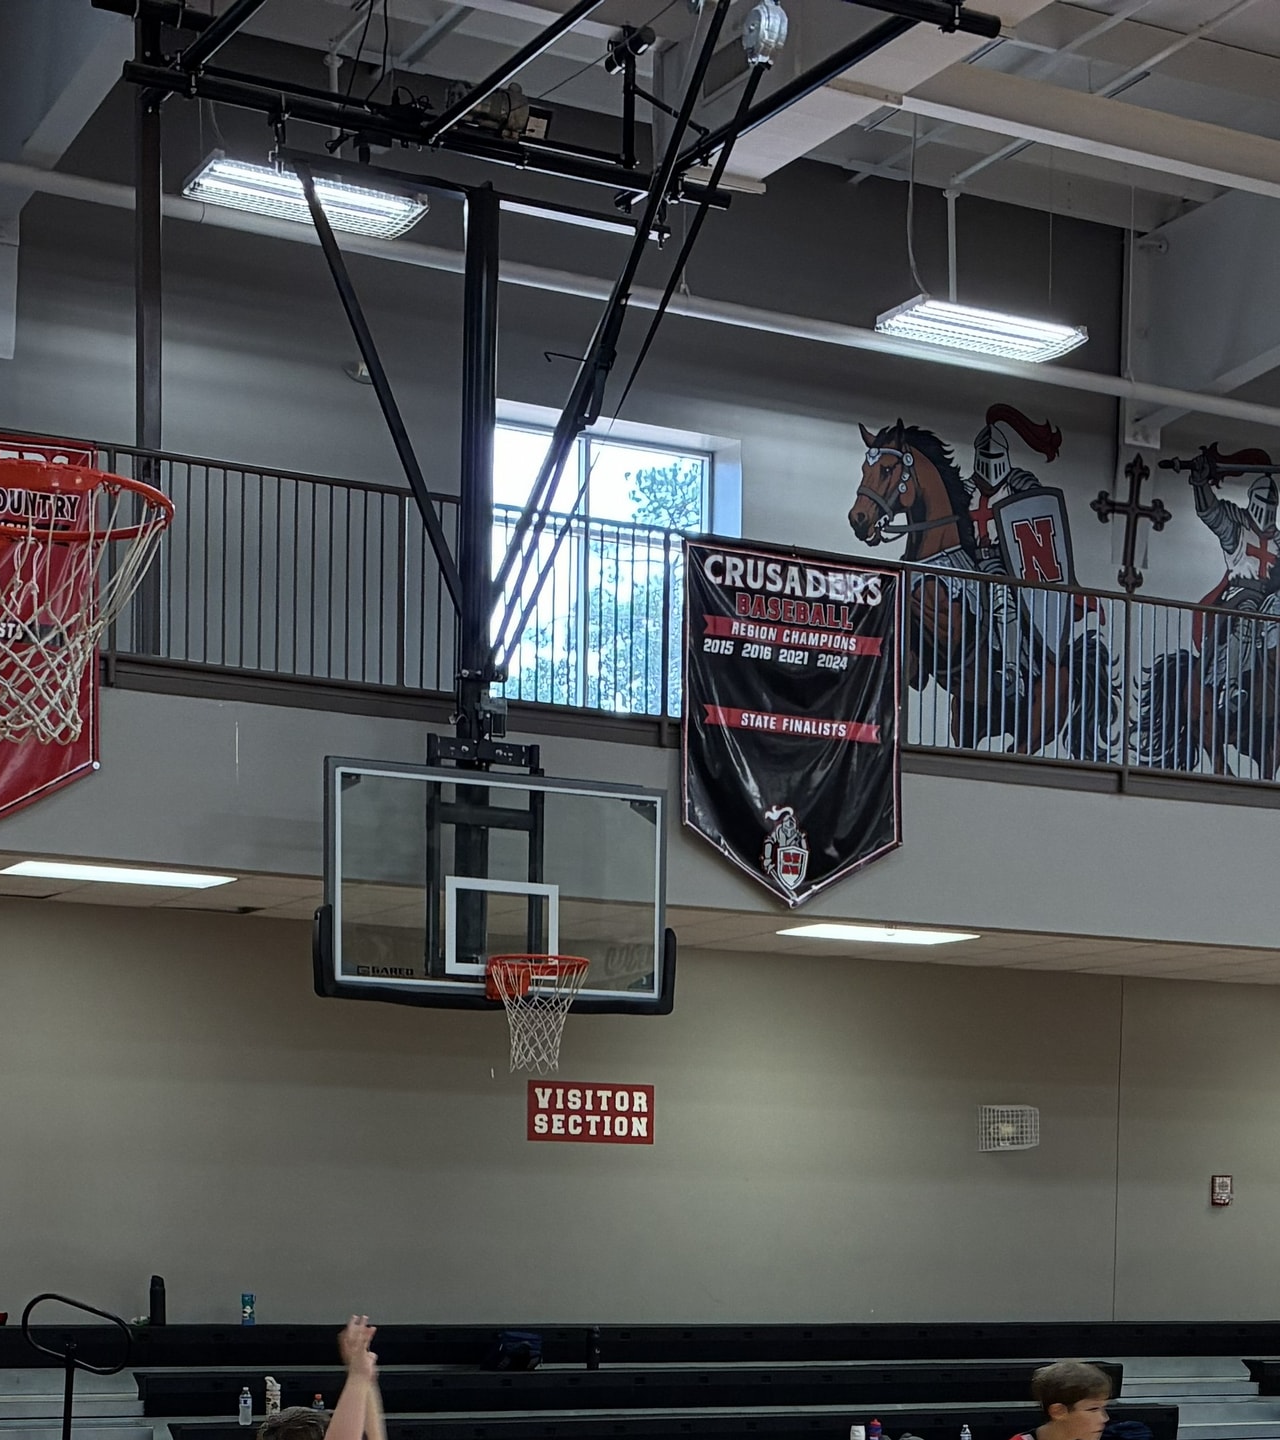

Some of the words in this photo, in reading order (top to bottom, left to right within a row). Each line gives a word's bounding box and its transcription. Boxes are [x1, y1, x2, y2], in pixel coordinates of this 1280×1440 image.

[703, 554, 882, 607] CRUSADERS
[735, 592, 854, 631] BASEBALL
[731, 620, 777, 642] REGION
[782, 628, 857, 652] CHAMPIONS
[703, 638, 734, 655] 2015
[741, 643, 772, 660] 2016
[778, 648, 809, 665] 2021
[817, 653, 848, 671] 2024
[740, 711, 778, 731] STATE
[782, 716, 847, 738] FINALISTS
[534, 1087, 649, 1113] VISITOR
[534, 1113, 648, 1138] SECTION
